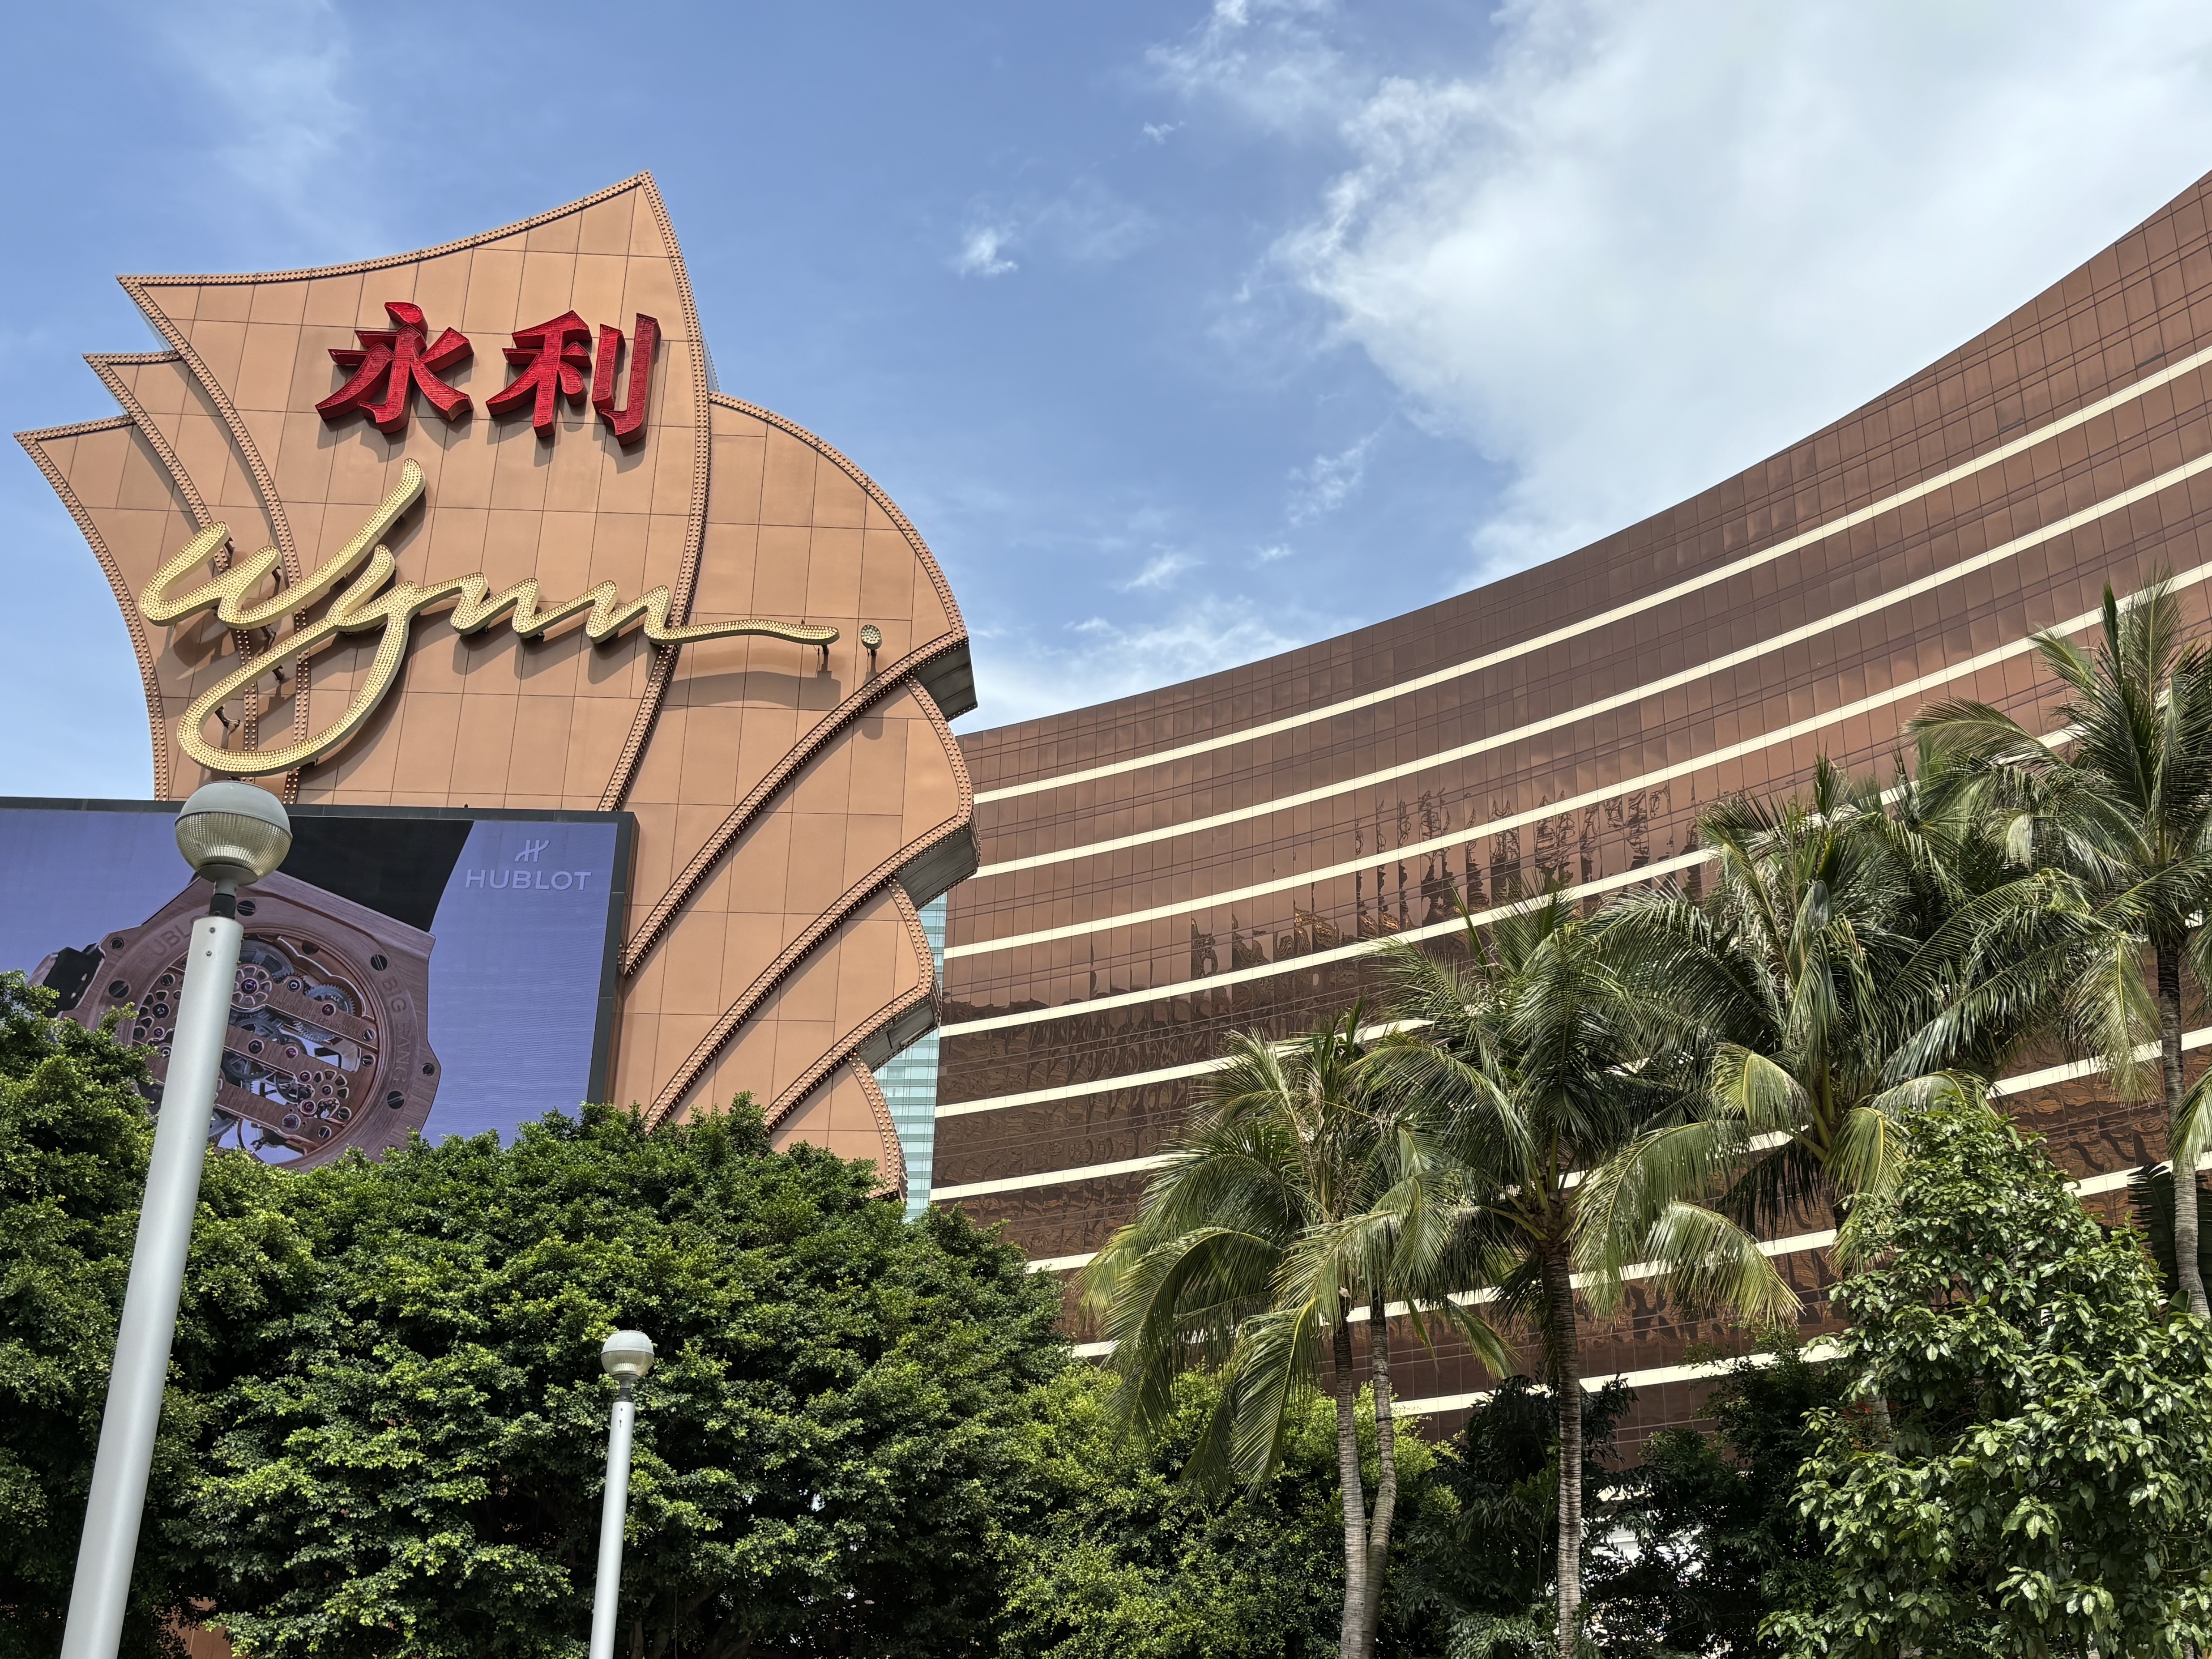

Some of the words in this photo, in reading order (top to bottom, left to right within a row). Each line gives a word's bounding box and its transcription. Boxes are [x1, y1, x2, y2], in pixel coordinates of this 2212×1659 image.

[316, 302, 661, 446] 永利
[465, 869, 592, 891] HUBLOT
[382, 976, 407, 1013] BIG
